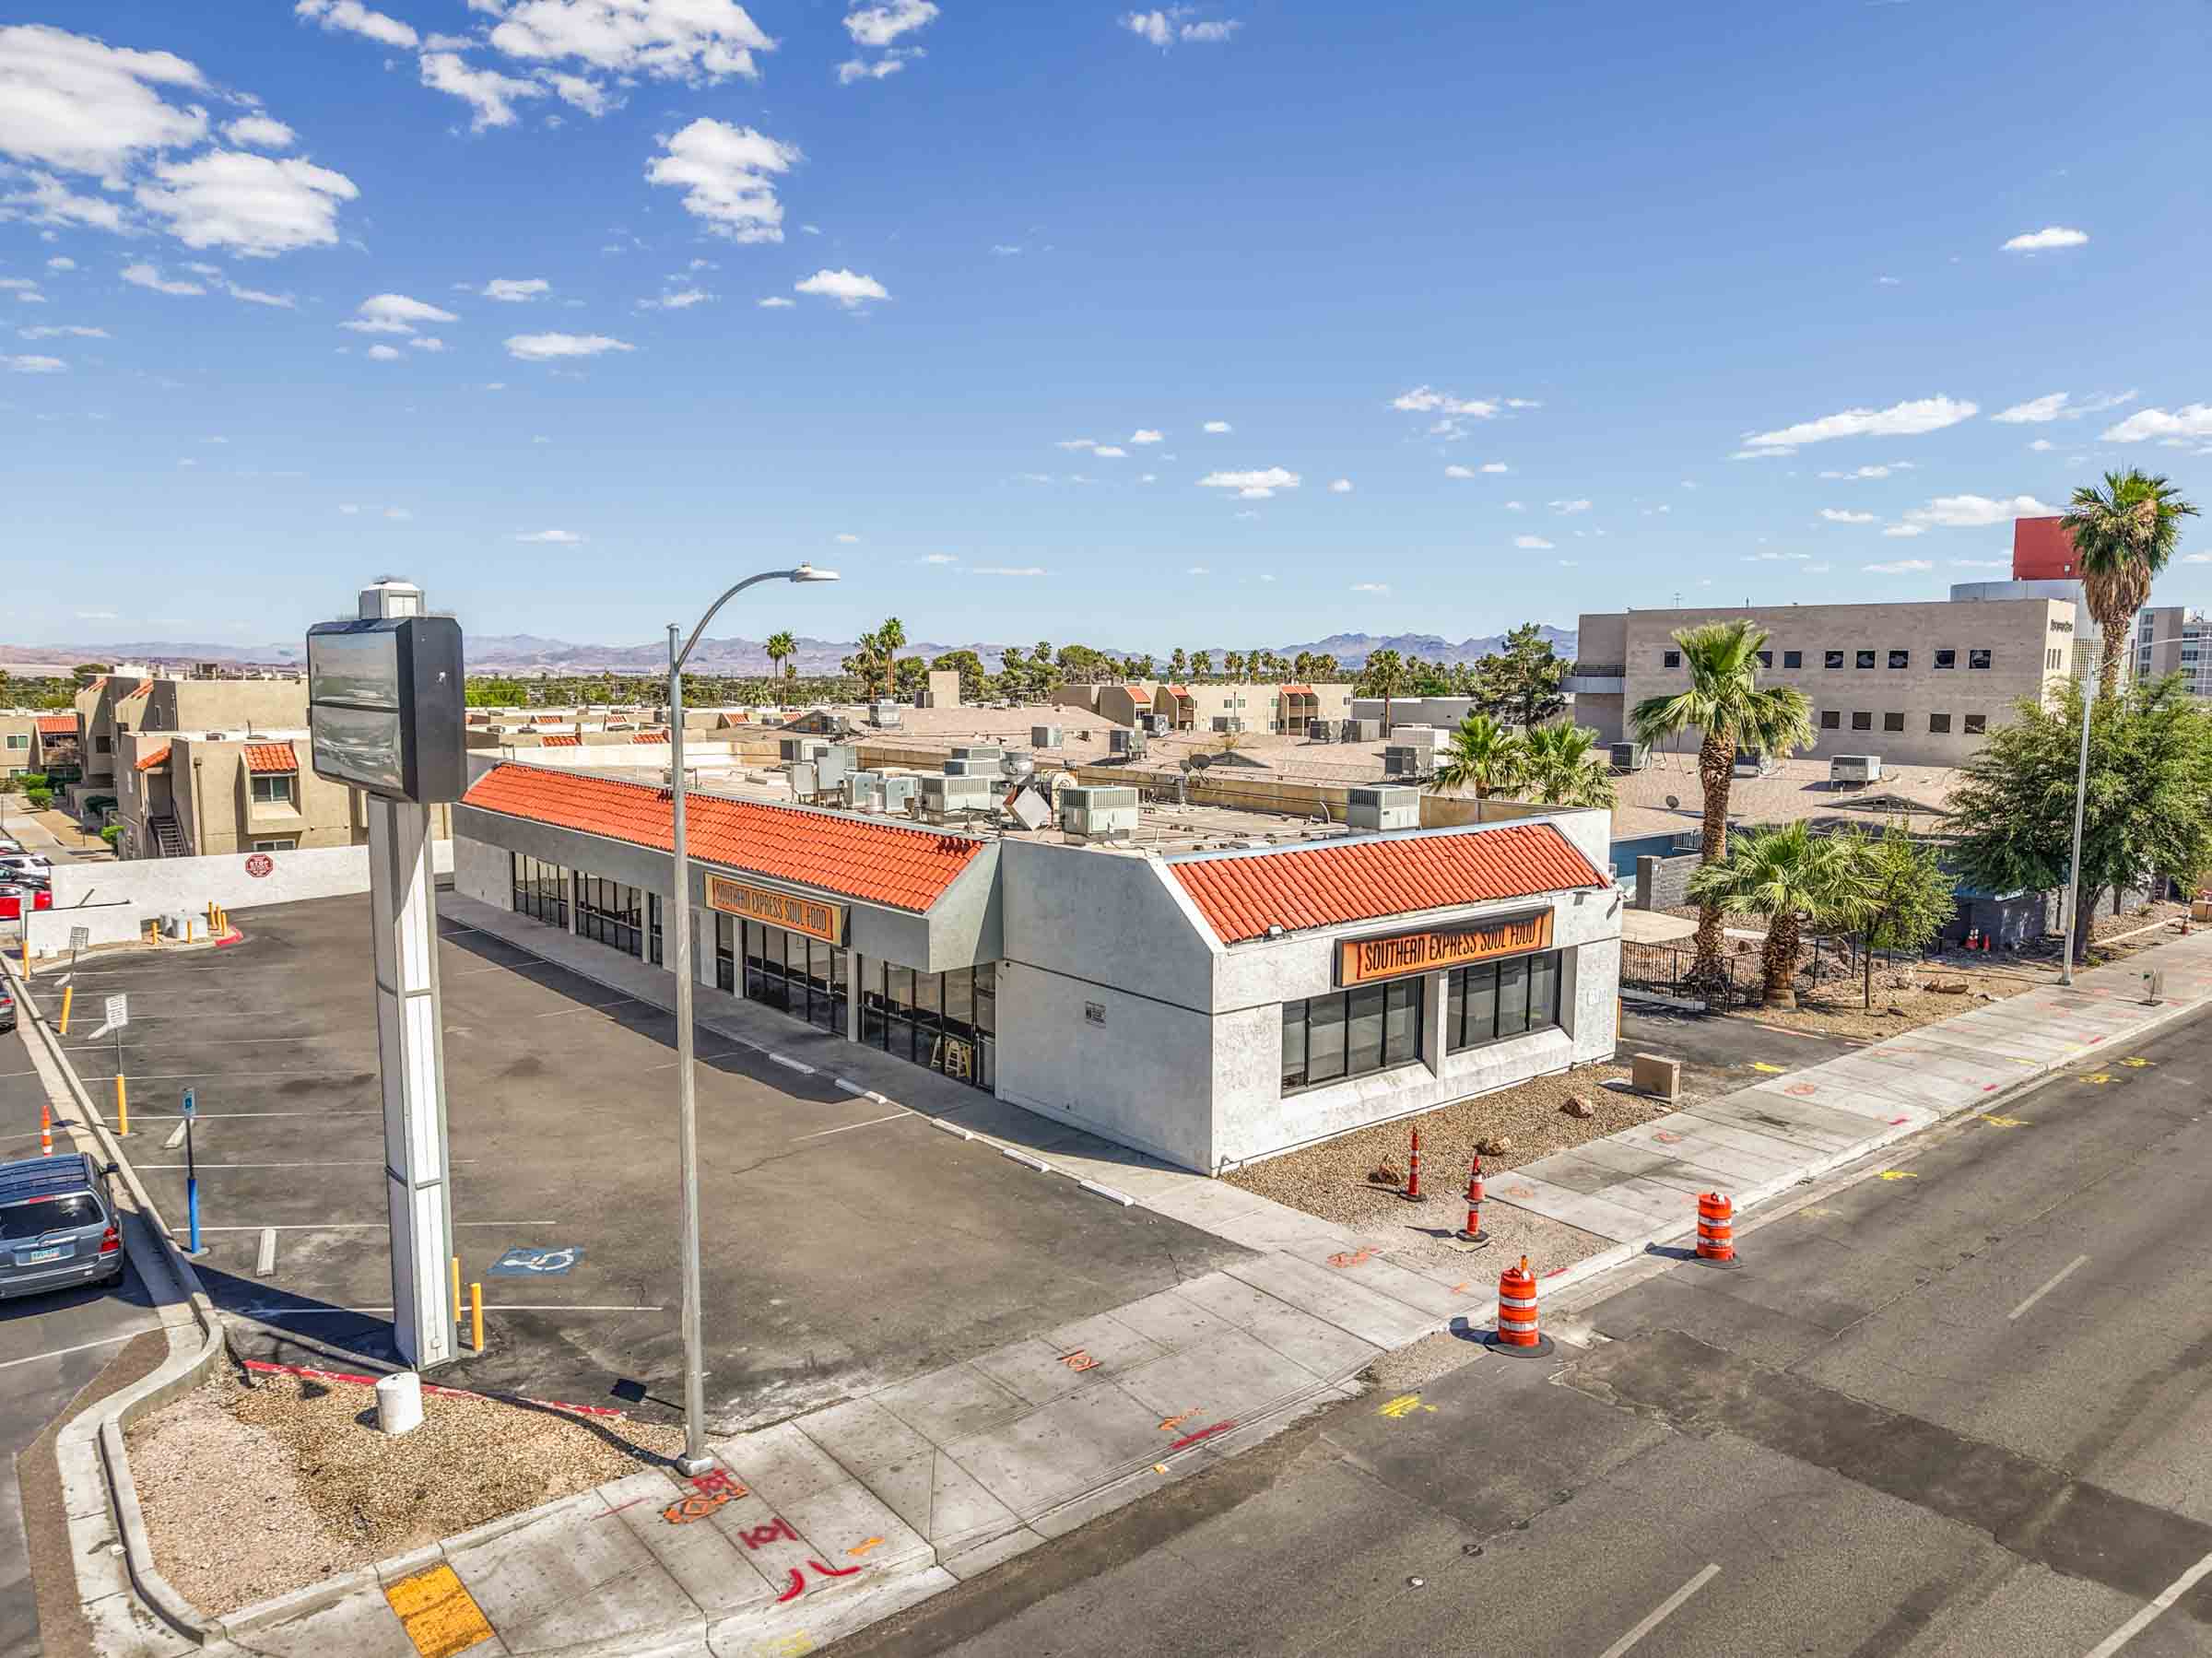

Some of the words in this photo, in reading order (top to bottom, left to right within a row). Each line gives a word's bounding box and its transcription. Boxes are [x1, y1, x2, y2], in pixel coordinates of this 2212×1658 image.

[716, 883, 749, 909] SOUTHERN
[752, 891, 782, 919] EXPRESS
[784, 900, 805, 925] SOUL
[806, 904, 827, 932] FOOD
[1365, 935, 1425, 971] SOUTHERN
[1429, 932, 1477, 960] EXPRESS
[1480, 925, 1506, 952] SOUL
[1510, 920, 1535, 946] FOOD
